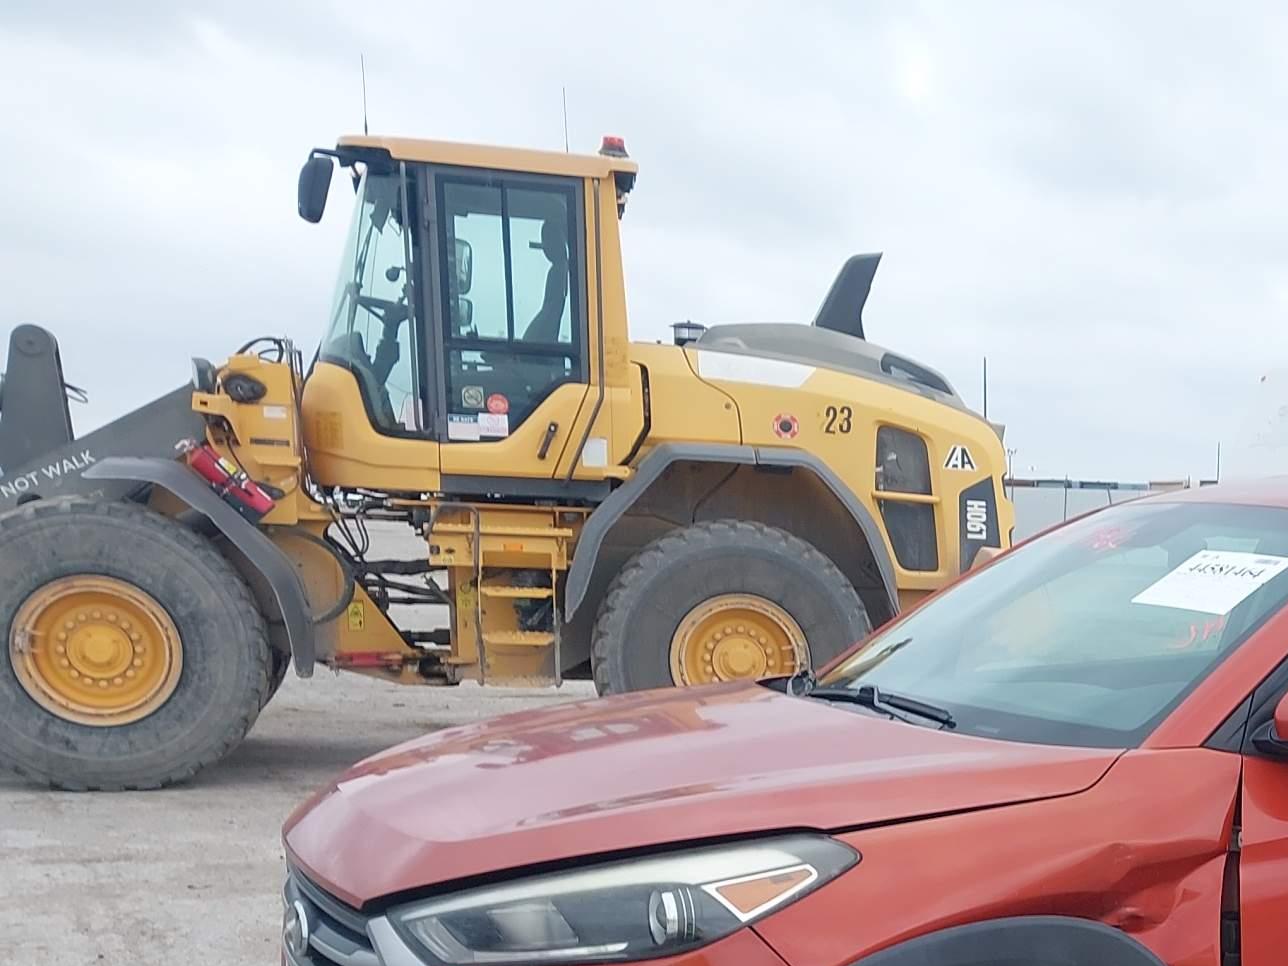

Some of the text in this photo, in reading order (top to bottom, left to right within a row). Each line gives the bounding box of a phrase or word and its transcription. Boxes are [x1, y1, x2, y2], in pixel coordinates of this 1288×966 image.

[824, 406, 852, 434] 23
[0, 449, 96, 498] NOT WALK
[966, 499, 987, 540] L90H
